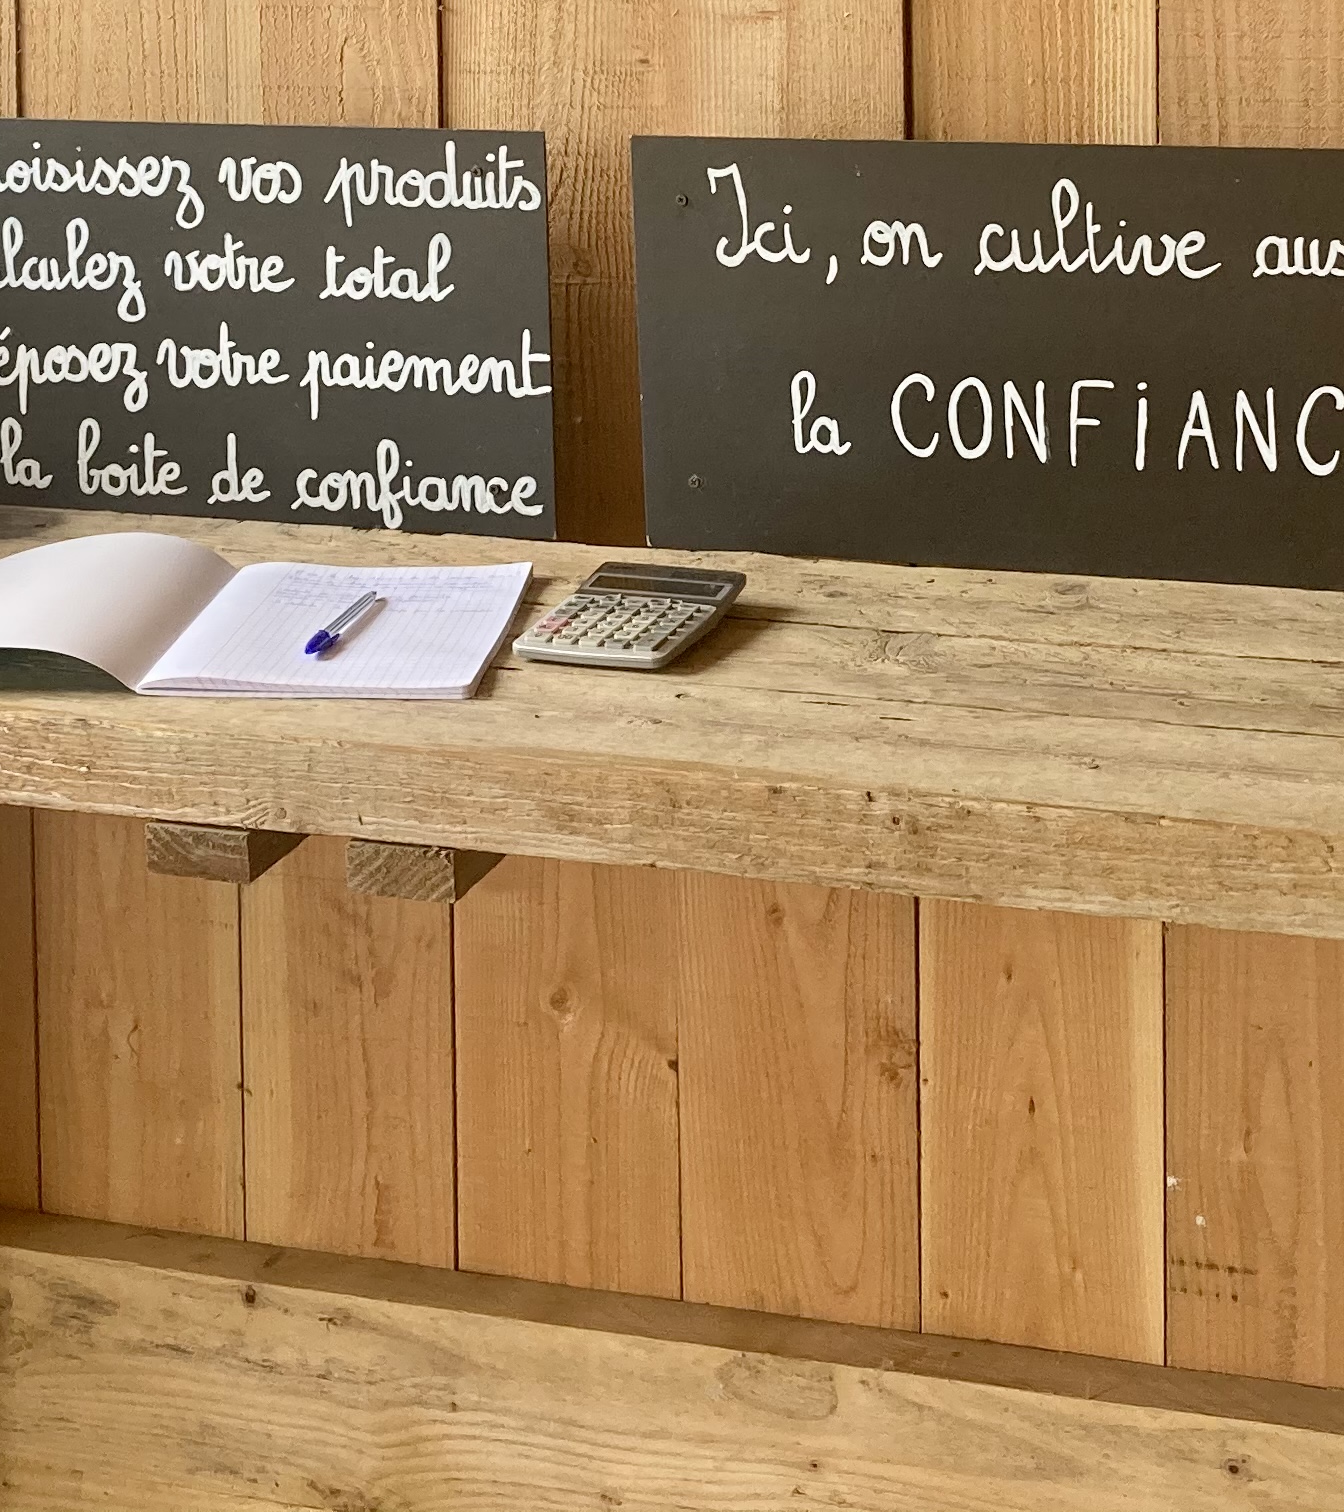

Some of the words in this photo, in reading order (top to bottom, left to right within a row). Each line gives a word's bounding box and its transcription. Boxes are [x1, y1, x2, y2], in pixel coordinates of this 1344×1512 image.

[219, 154, 303, 206] vos
[324, 140, 543, 227] produits
[860, 216, 942, 269] on
[974, 178, 1221, 280] cultive
[164, 233, 296, 294] votre
[320, 233, 454, 302] total
[156, 322, 290, 389] votre
[300, 328, 552, 420] paiement
[790, 370, 852, 456] la
[1, 417, 52, 489] la
[77, 418, 188, 496] boite
[207, 434, 270, 505] de
[291, 438, 544, 529] confiance
